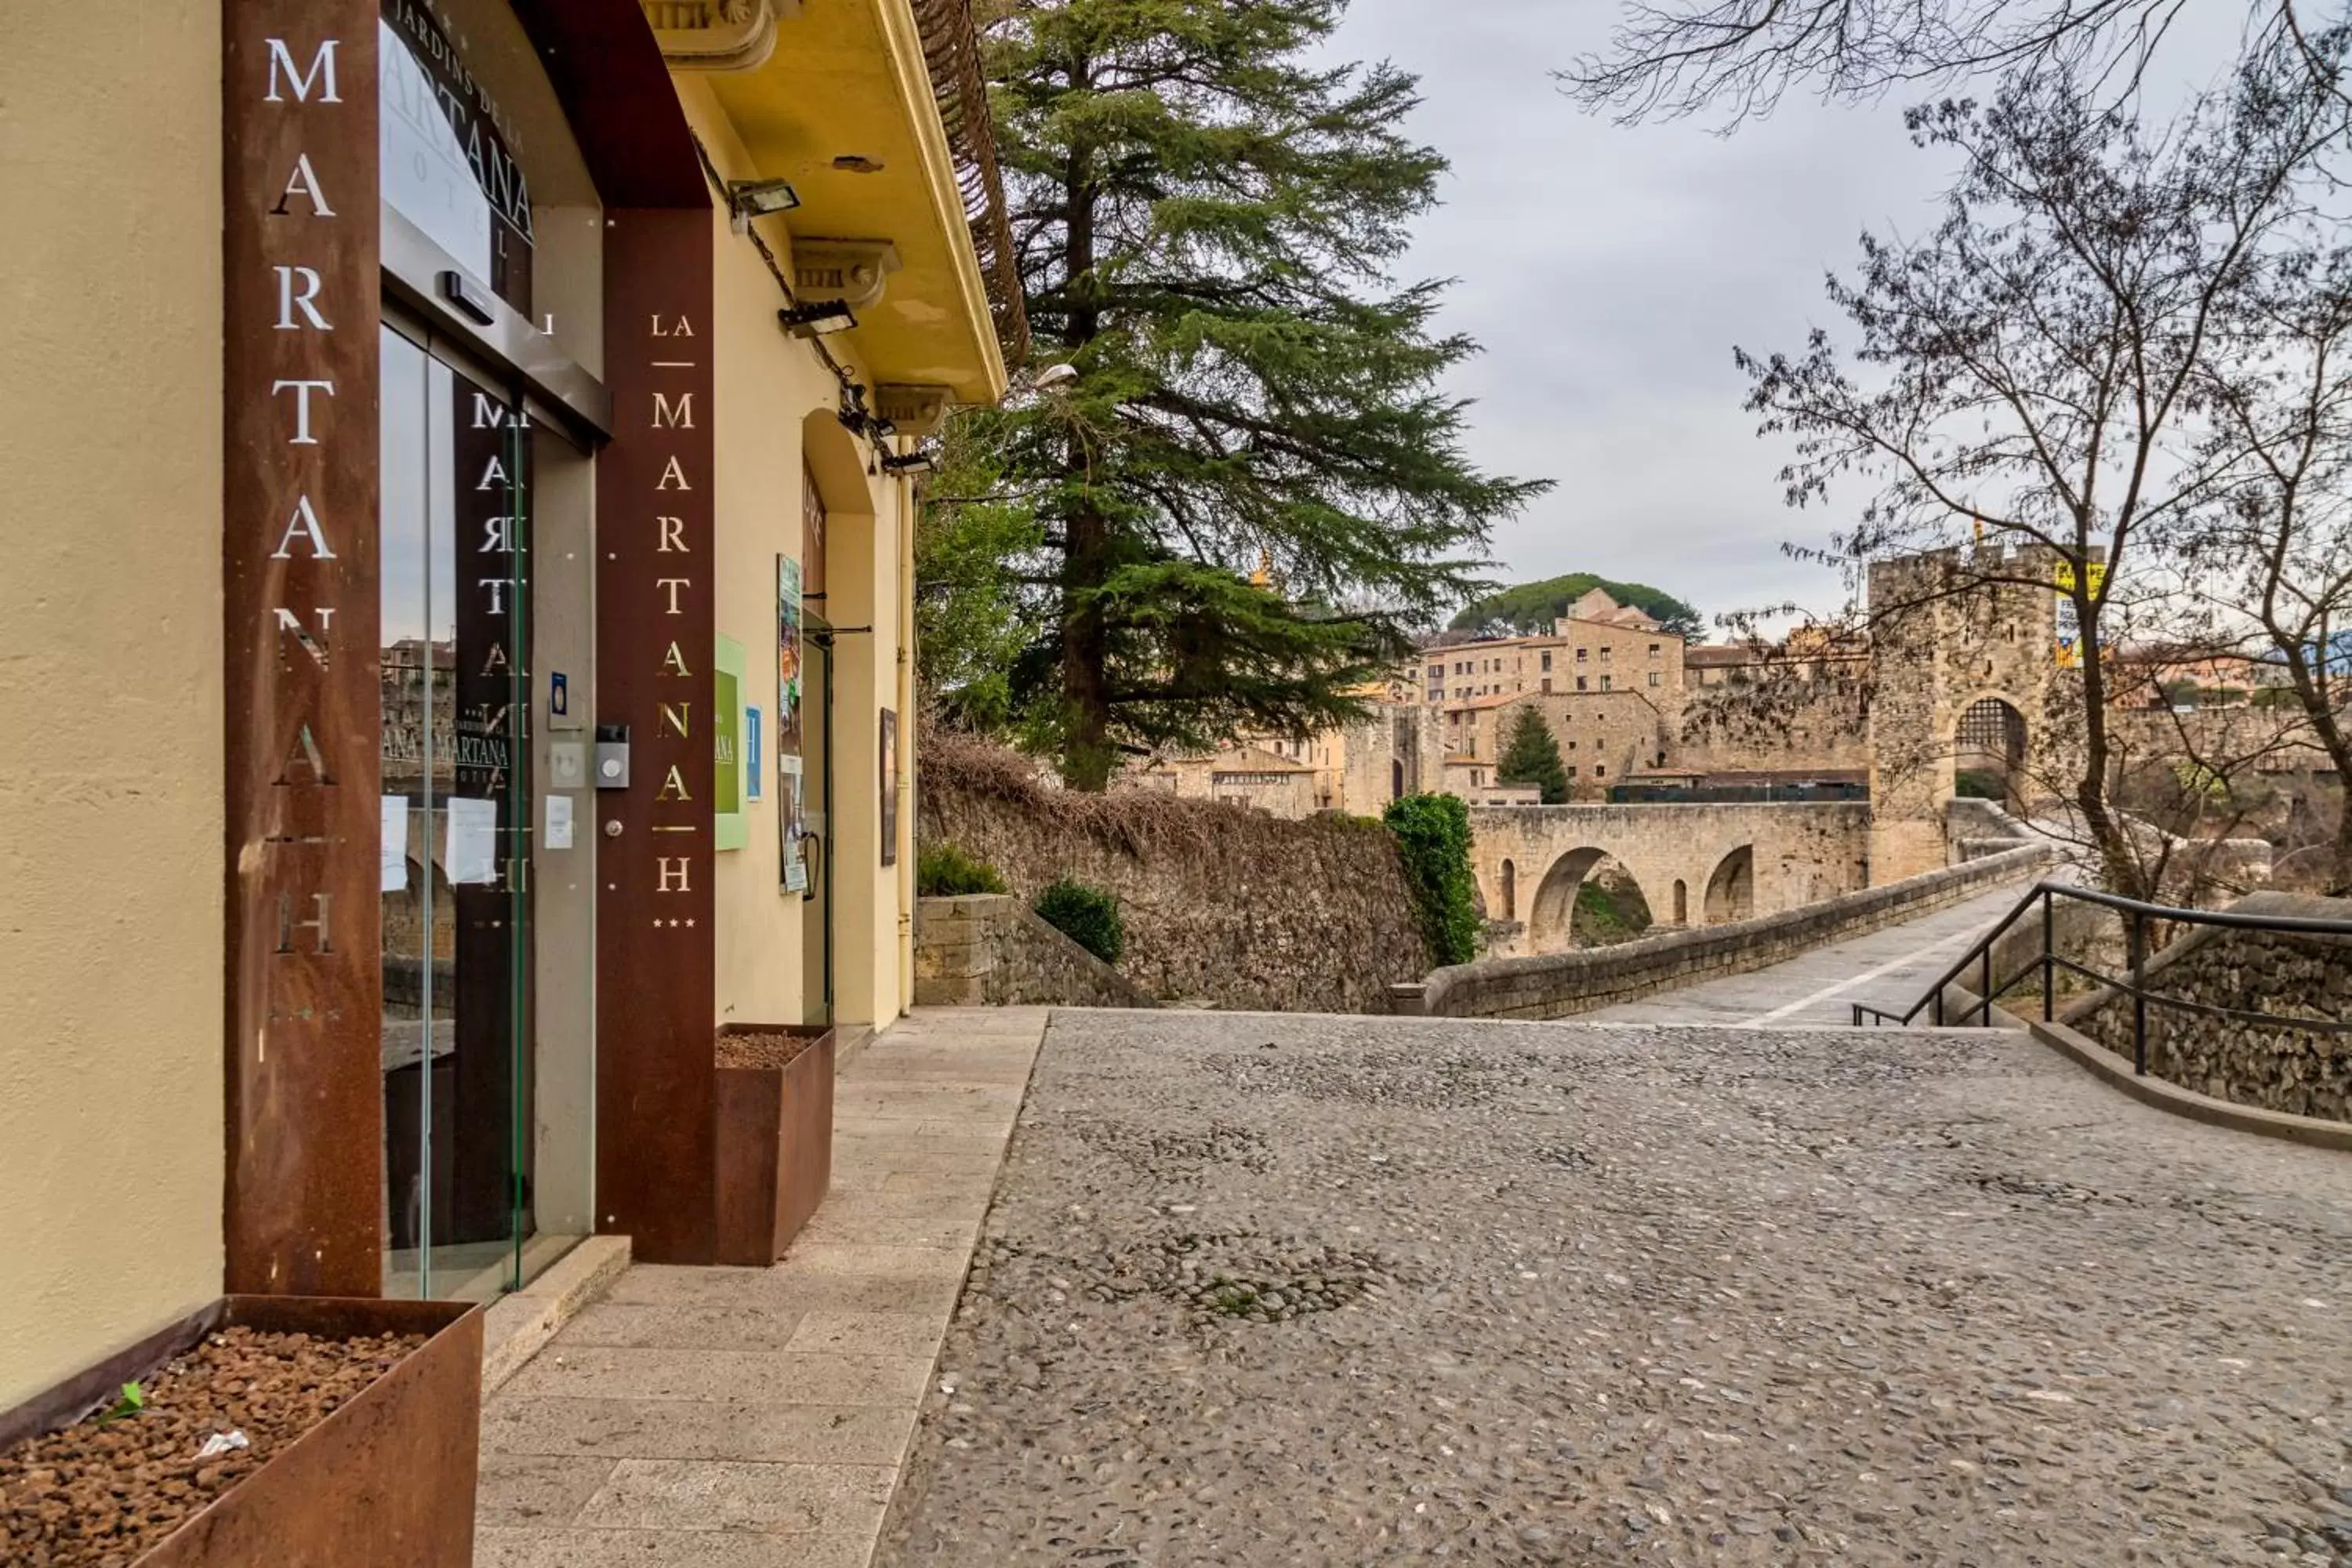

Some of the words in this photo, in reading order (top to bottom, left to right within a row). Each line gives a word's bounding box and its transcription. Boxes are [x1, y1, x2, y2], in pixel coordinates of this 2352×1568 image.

[479, 86, 500, 128] DE
[652, 314, 695, 337] LA
[263, 38, 343, 786] MARTANA
[652, 392, 695, 801] MARTANA
[655, 857, 691, 891] H
[271, 892, 335, 955] H
